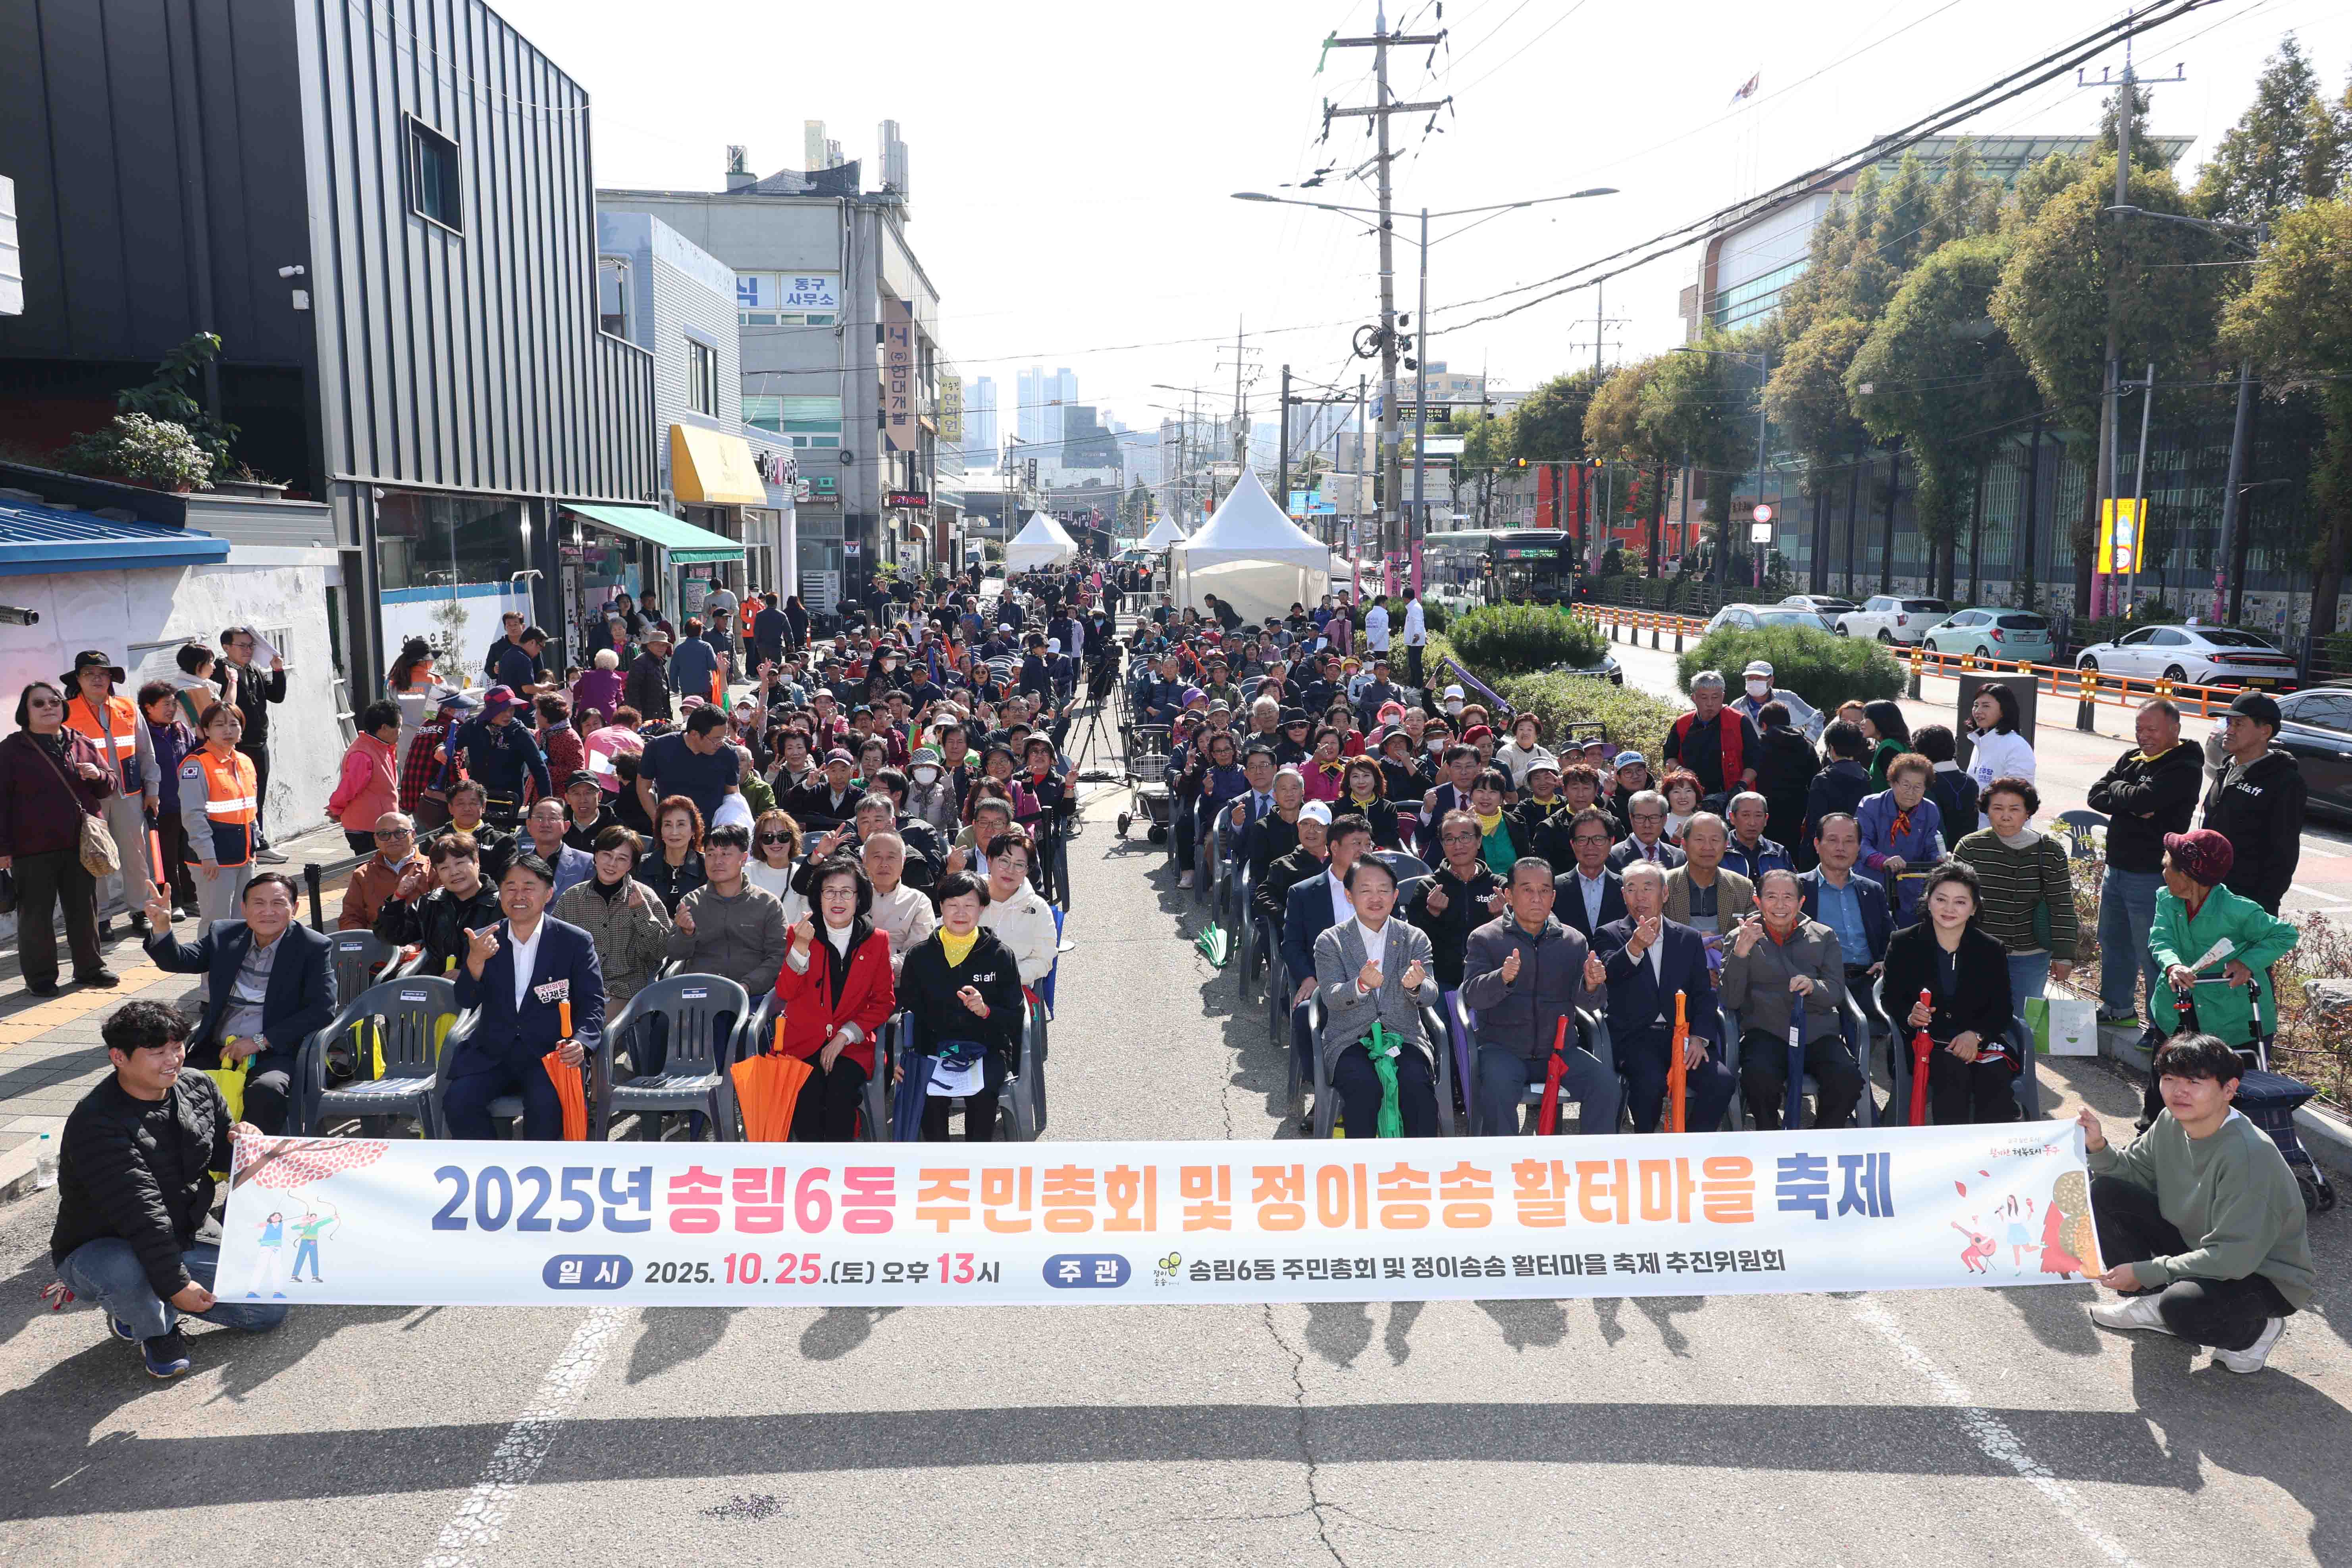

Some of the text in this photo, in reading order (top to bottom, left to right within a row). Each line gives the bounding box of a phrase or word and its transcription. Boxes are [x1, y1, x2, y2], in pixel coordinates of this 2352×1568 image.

[795, 278, 825, 291] 동구
[786, 293, 833, 305] 사무소
[2236, 782, 2263, 796] staff
[540, 982, 564, 992] 국민의힘
[541, 988, 567, 1002] 심재돈
[2012, 1147, 2042, 1156] 행복도시
[432, 1153, 1894, 1233] 2025년 송림6동 주민총회 및 정이송송 활터마을 축제
[645, 1262, 715, 1283] 2025.
[882, 1262, 928, 1283] 오후
[938, 1254, 999, 1283] 13시
[1190, 1250, 1785, 1281] 송림6동 주민총회 및 정이송송 활터마을 축제 추진위원회
[1154, 1278, 1168, 1287] 송송
